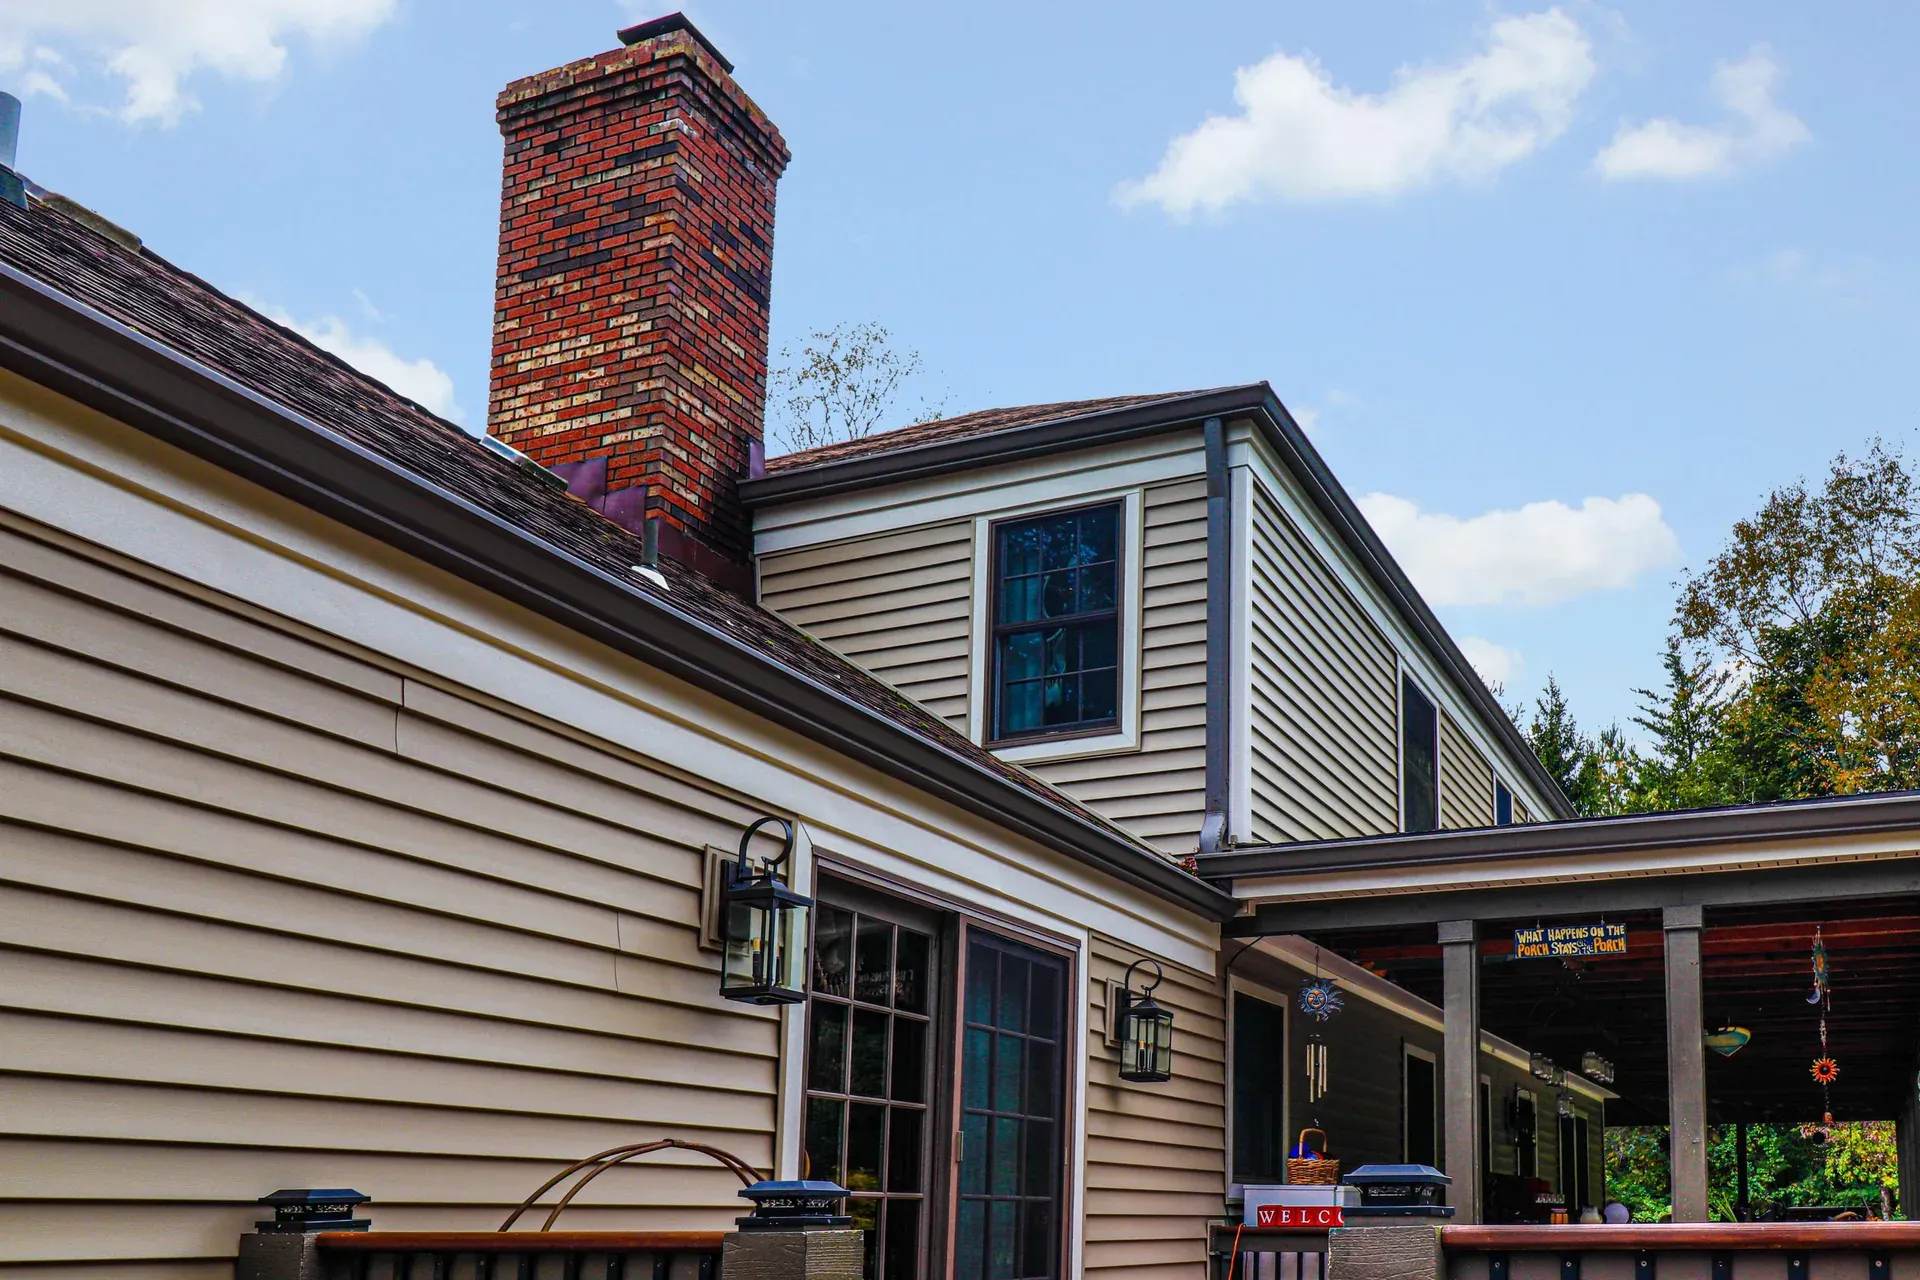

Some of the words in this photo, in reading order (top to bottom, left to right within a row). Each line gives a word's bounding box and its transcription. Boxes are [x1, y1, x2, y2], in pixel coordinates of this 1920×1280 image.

[1517, 930, 1544, 943] WHAT
[1548, 927, 1588, 941] HAPPENS
[1590, 926, 1604, 937] ON
[1606, 925, 1625, 935] THE
[1518, 943, 1549, 957] PORCH
[1551, 942, 1577, 955] STAYS
[1593, 937, 1625, 953] PORCH
